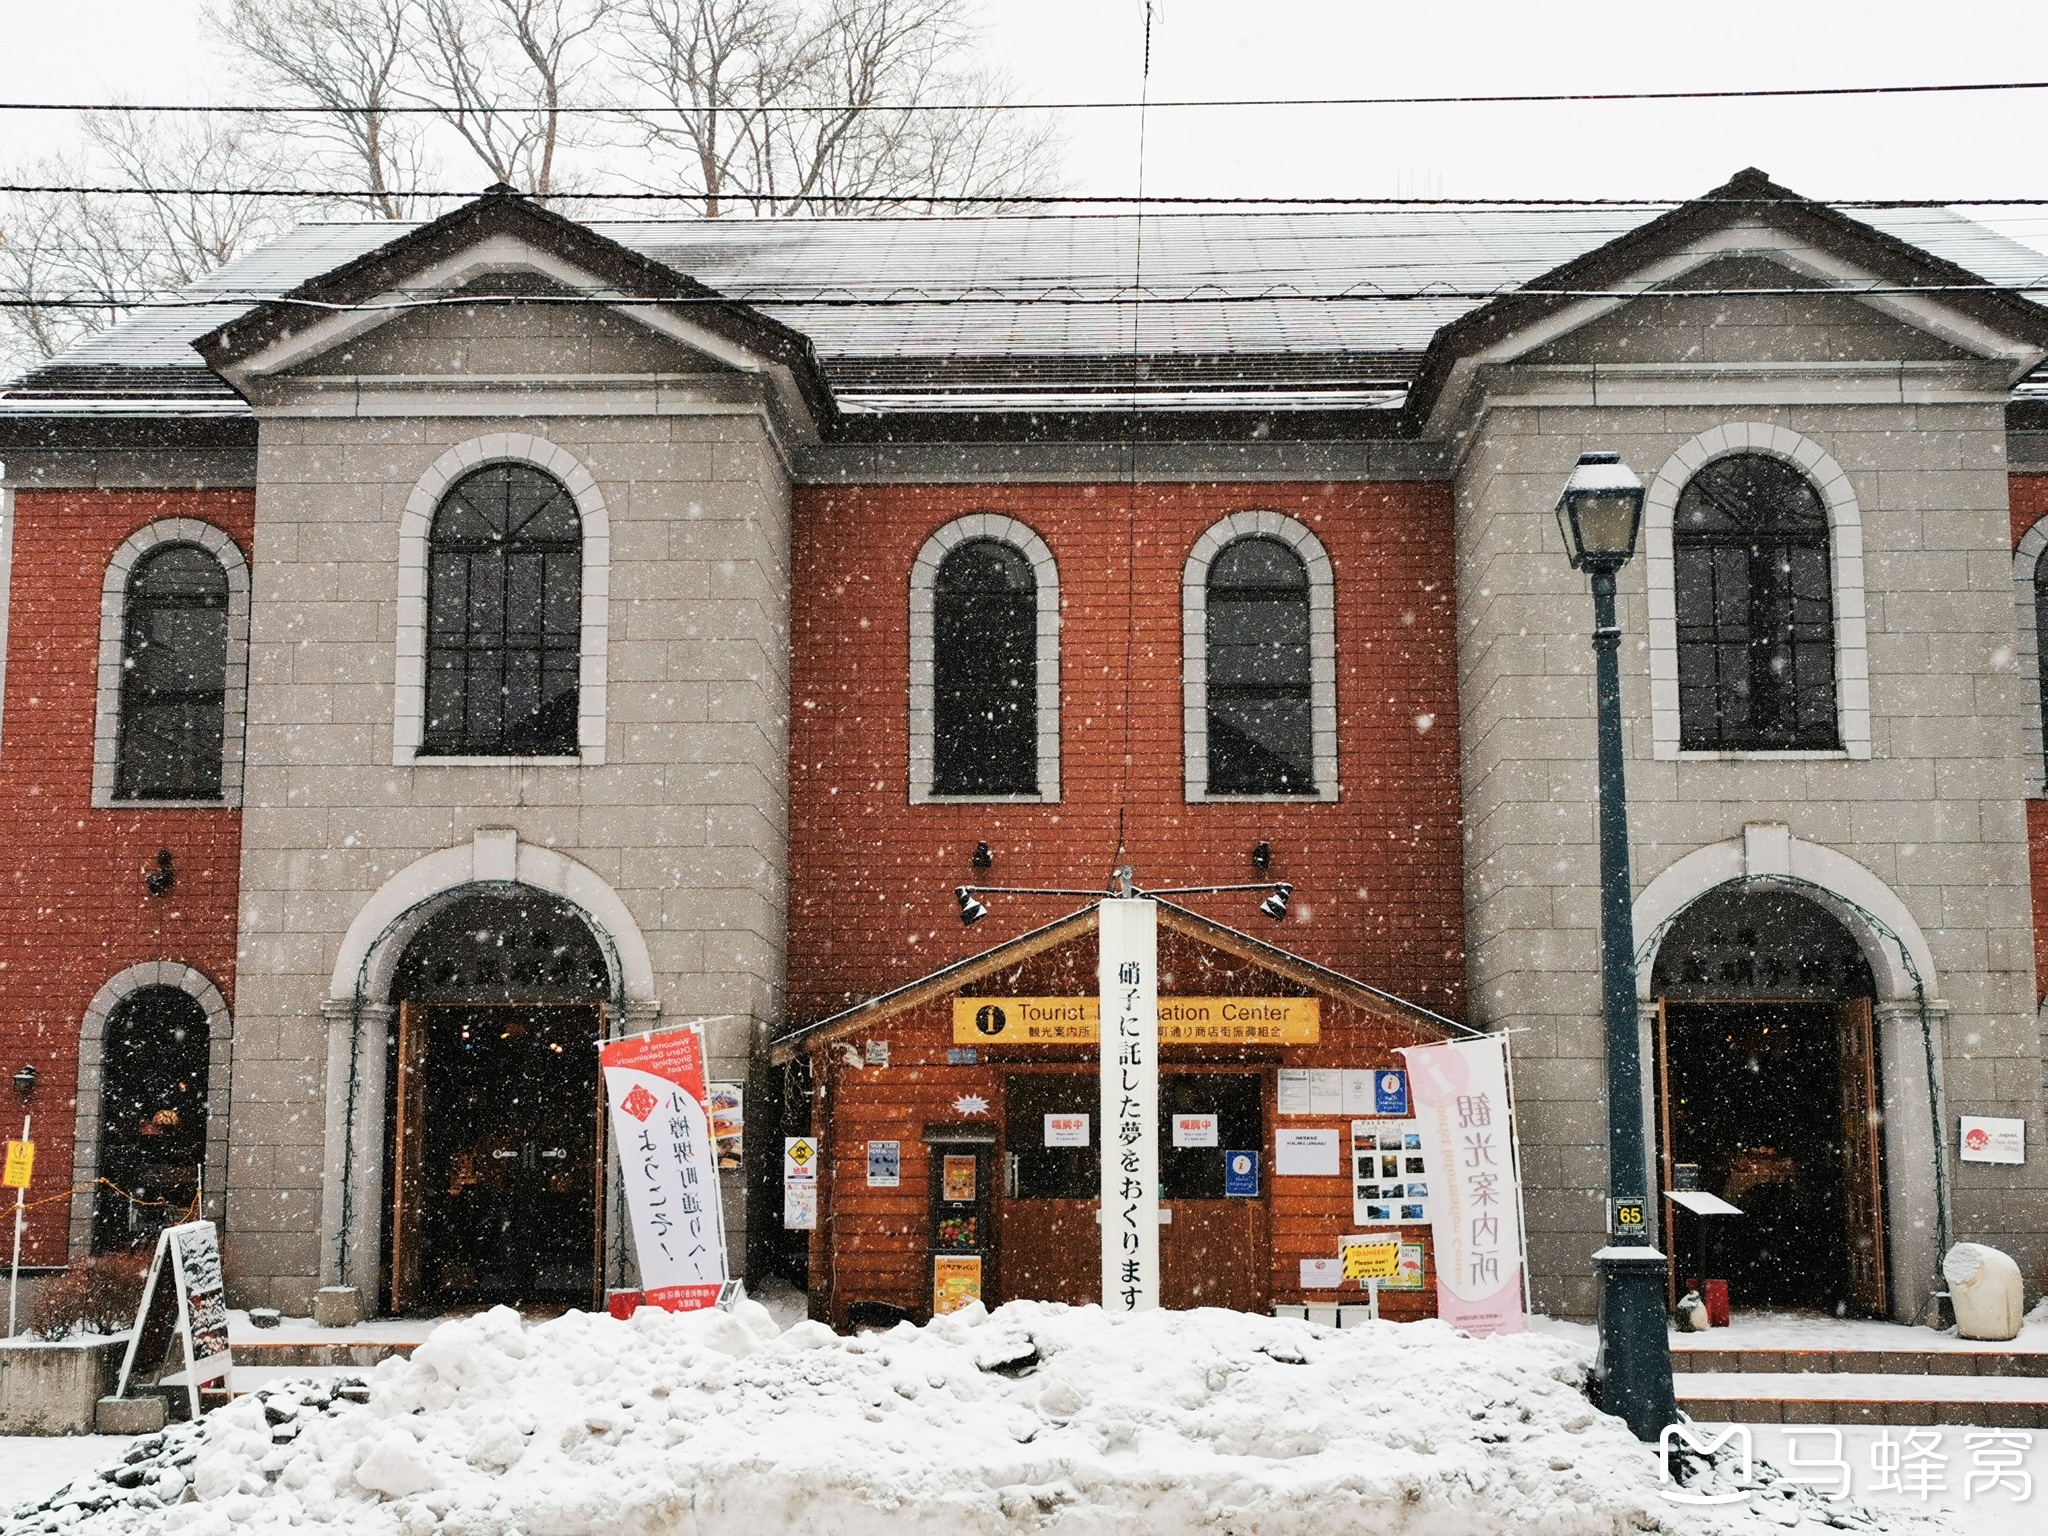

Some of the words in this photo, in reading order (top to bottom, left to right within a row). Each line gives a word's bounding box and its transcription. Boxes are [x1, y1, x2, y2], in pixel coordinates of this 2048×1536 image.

[1018, 1003, 1085, 1022] Tourist
[1097, 1003, 1210, 1022] Iation
[1221, 1003, 1290, 1022] Center
[1028, 1025, 1092, 1039] 観光案内所
[1157, 1025, 1283, 1039] 町通り商店街振興組合
[1117, 960, 1144, 1312] 硝子に託した夢をおくります
[2003, 1145, 2020, 1153] Shop
[1620, 1207, 1641, 1223] 65
[1352, 1248, 1390, 1258] !!DANGER!!
[1358, 1267, 1371, 1275] play
